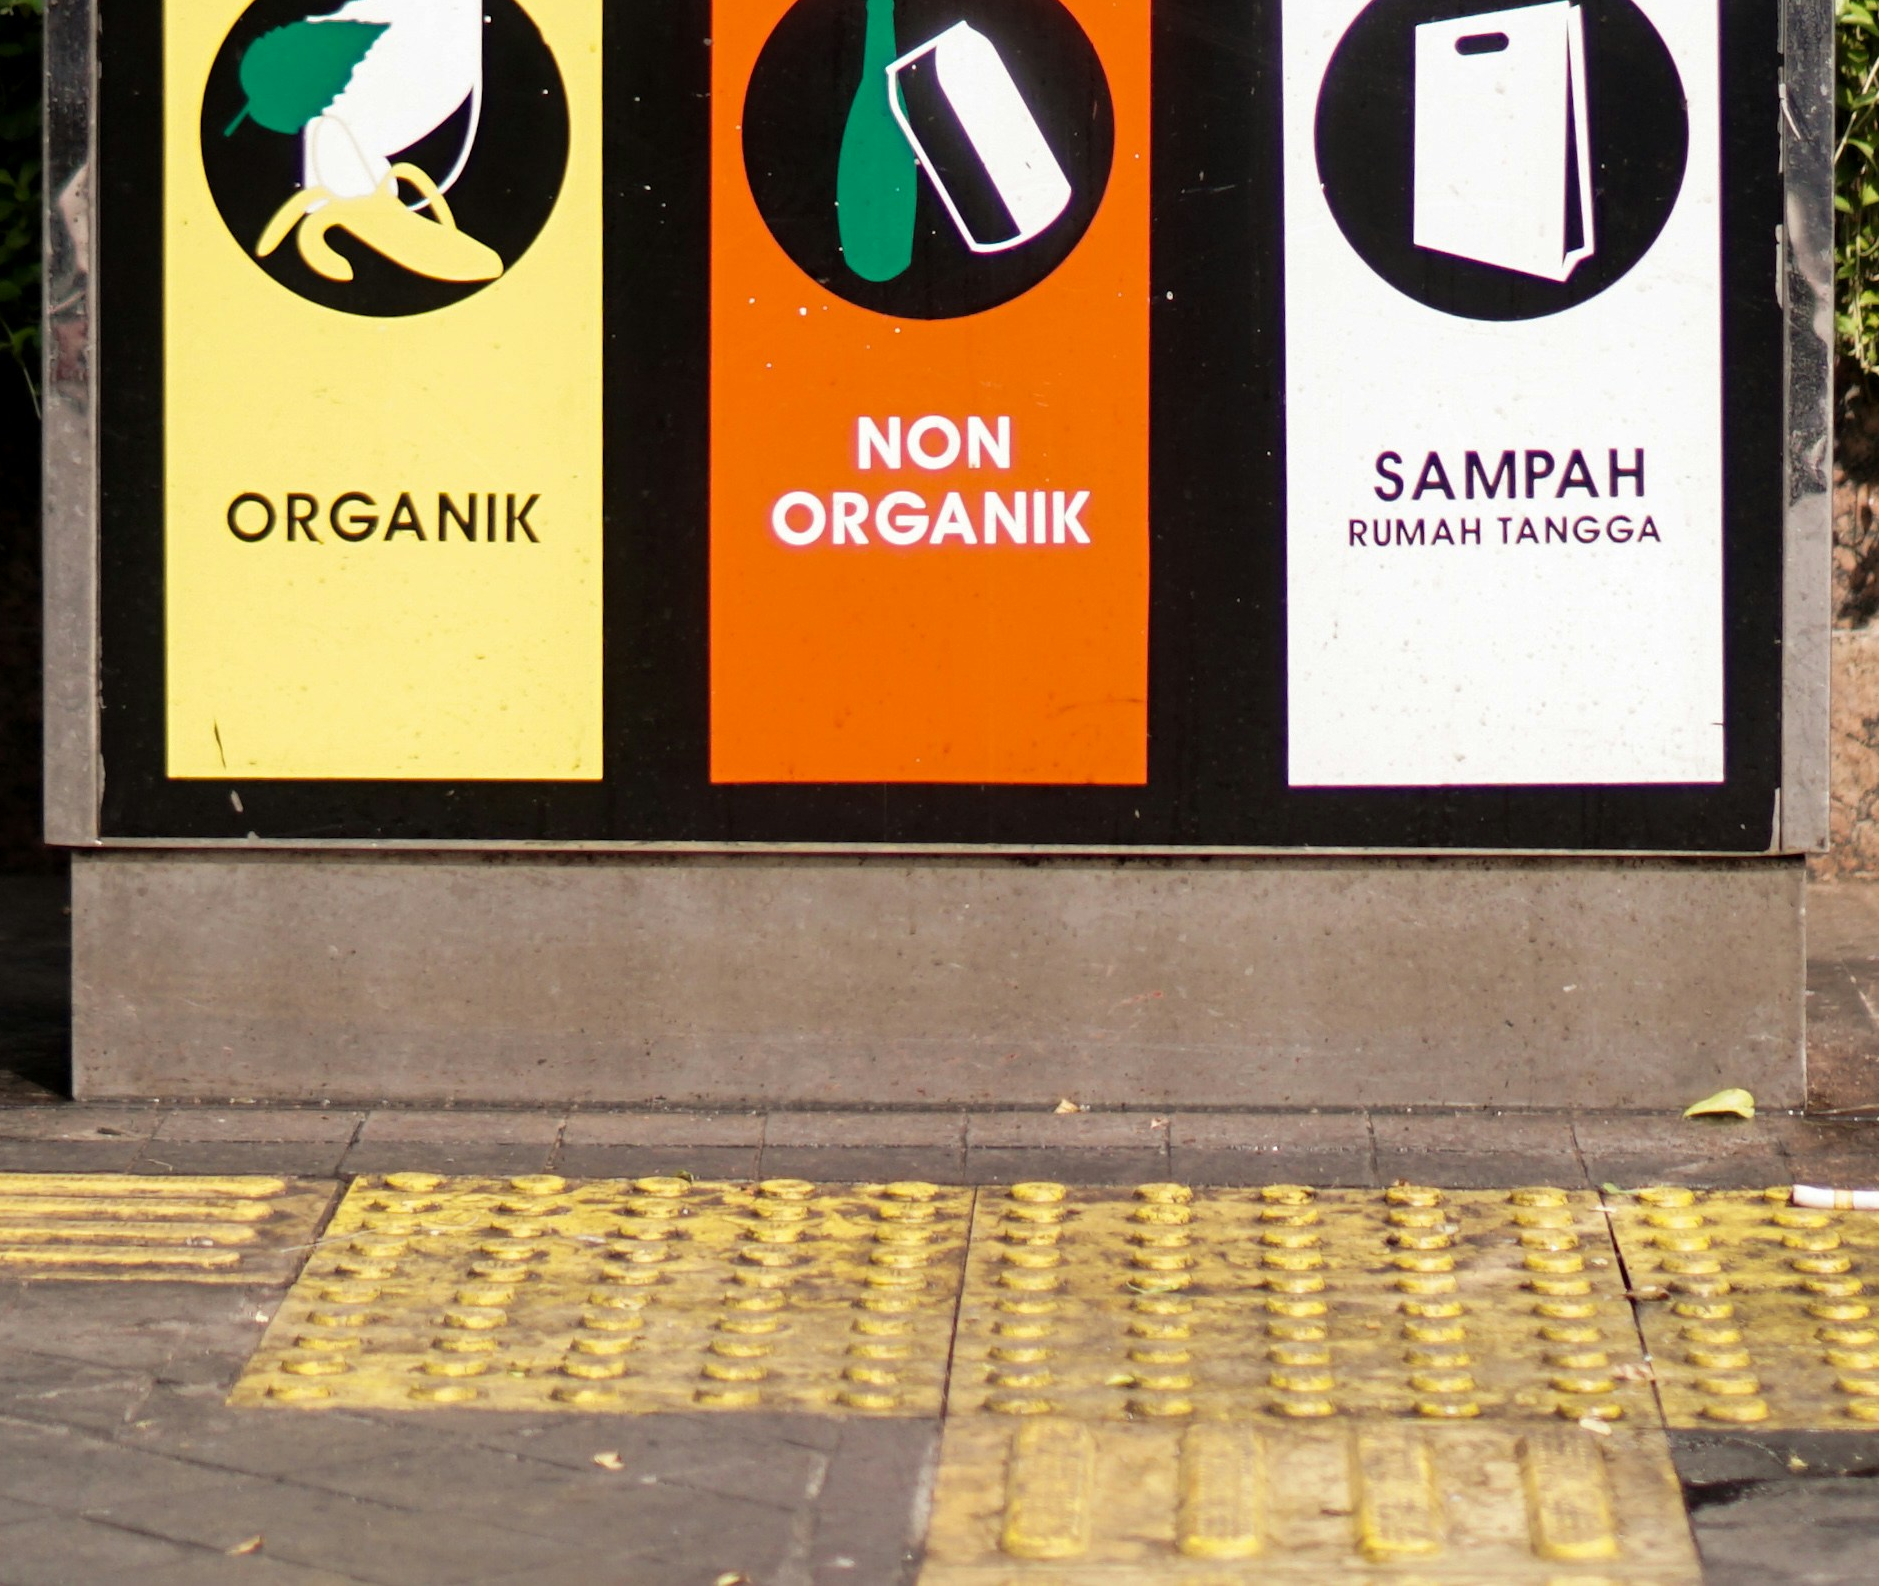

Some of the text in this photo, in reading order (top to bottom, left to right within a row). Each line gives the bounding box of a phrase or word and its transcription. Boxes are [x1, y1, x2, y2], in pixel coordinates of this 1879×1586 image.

[856, 414, 1012, 471] NON
[1374, 448, 1646, 502] SAMPAH
[226, 492, 541, 544] ORGANIK
[770, 489, 1091, 547] ORGANIK
[1348, 515, 1662, 547] RUMAH TANGGA
